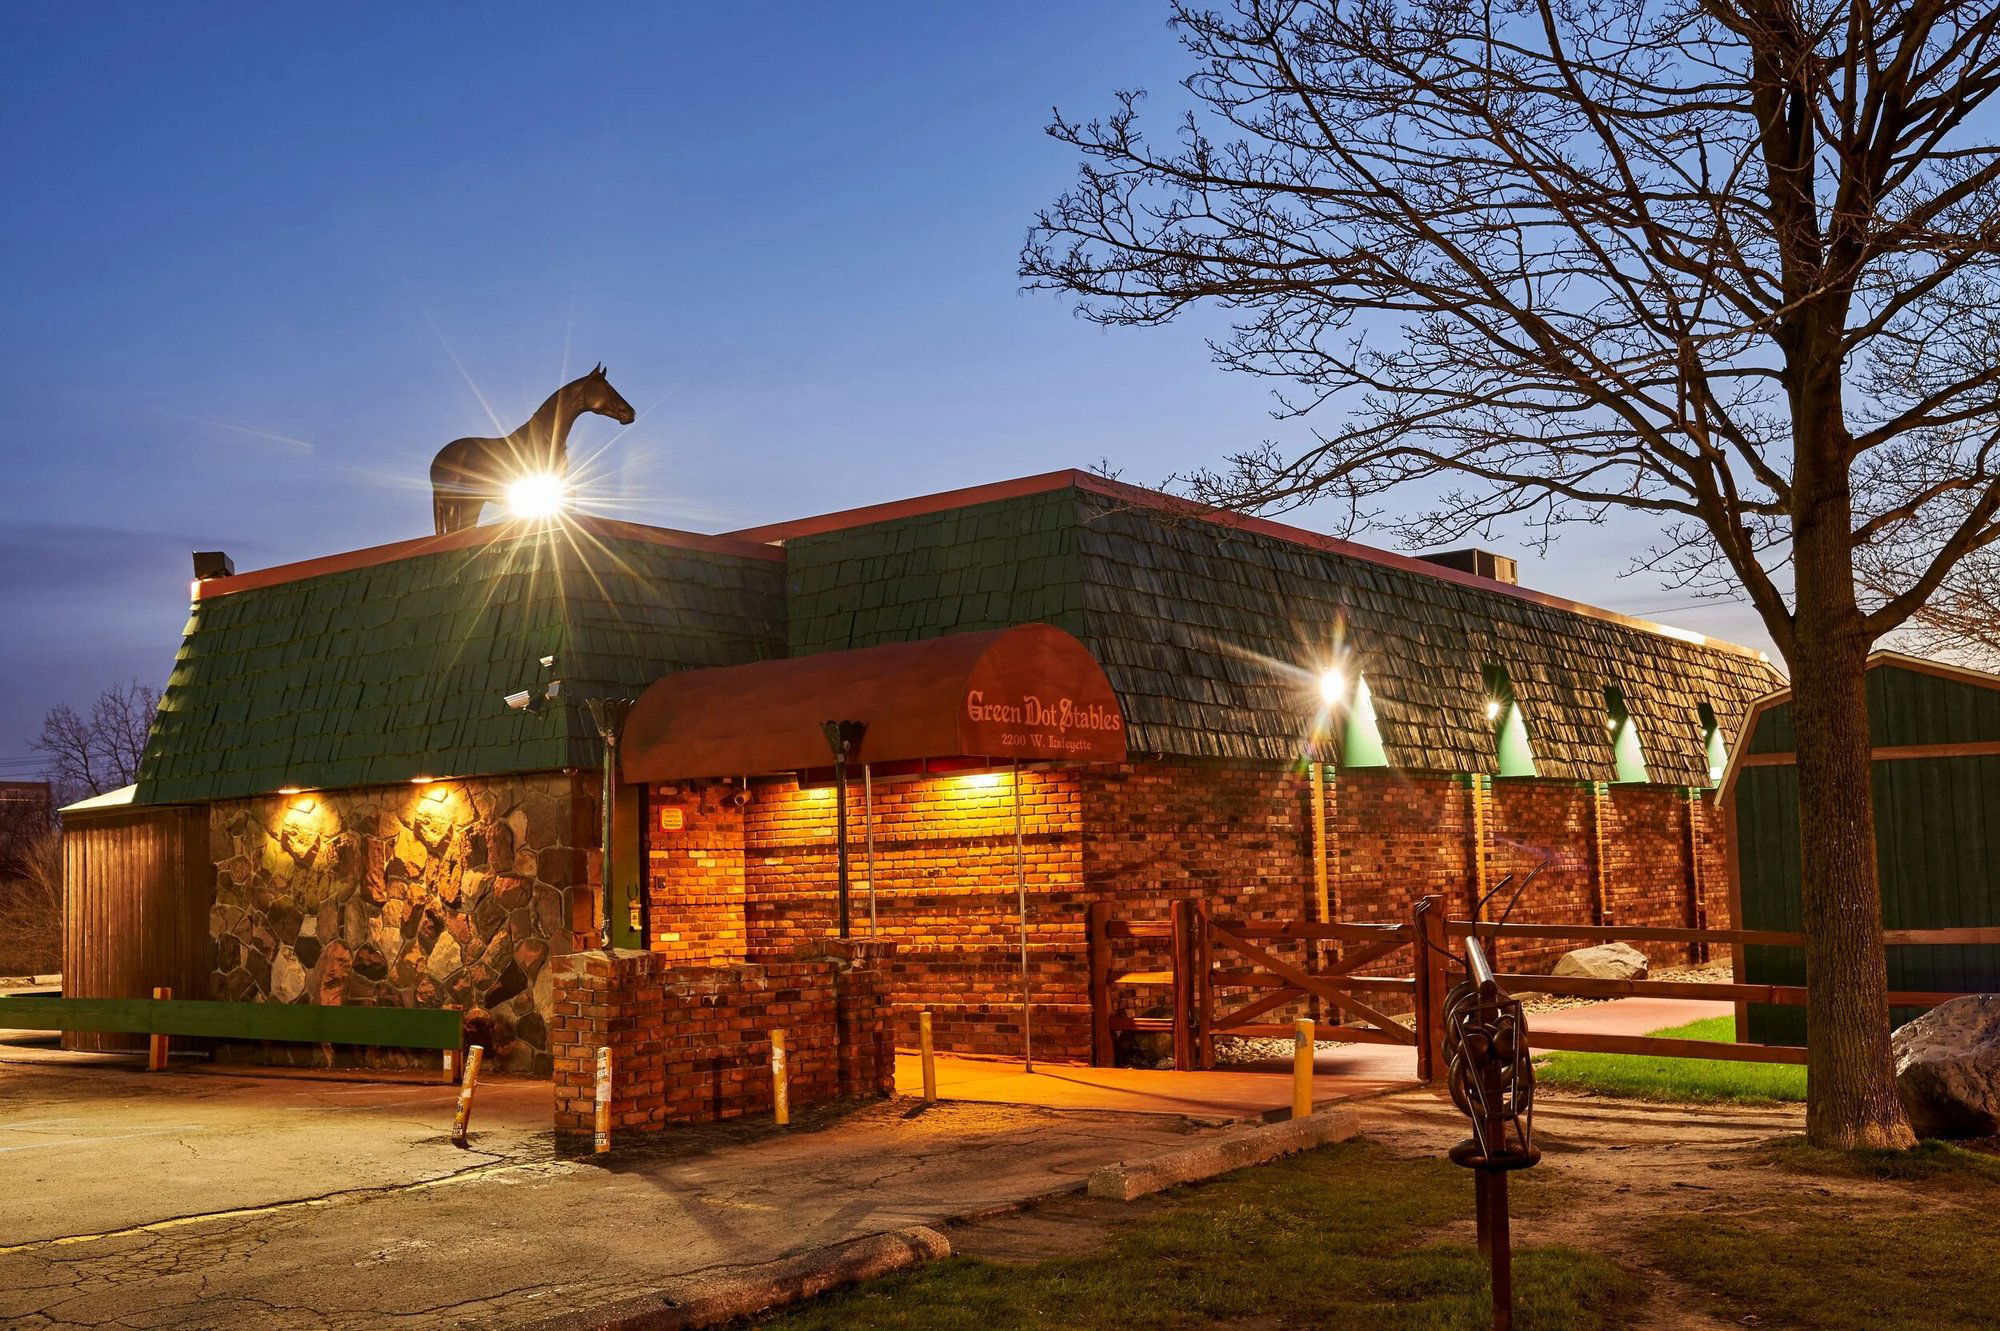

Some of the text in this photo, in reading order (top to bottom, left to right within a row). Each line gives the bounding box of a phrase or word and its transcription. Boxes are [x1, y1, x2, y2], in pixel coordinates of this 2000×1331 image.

[967, 690, 1121, 733] Green Dot Stables
[1001, 733, 1027, 746] 2200
[1030, 734, 1046, 748] W.
